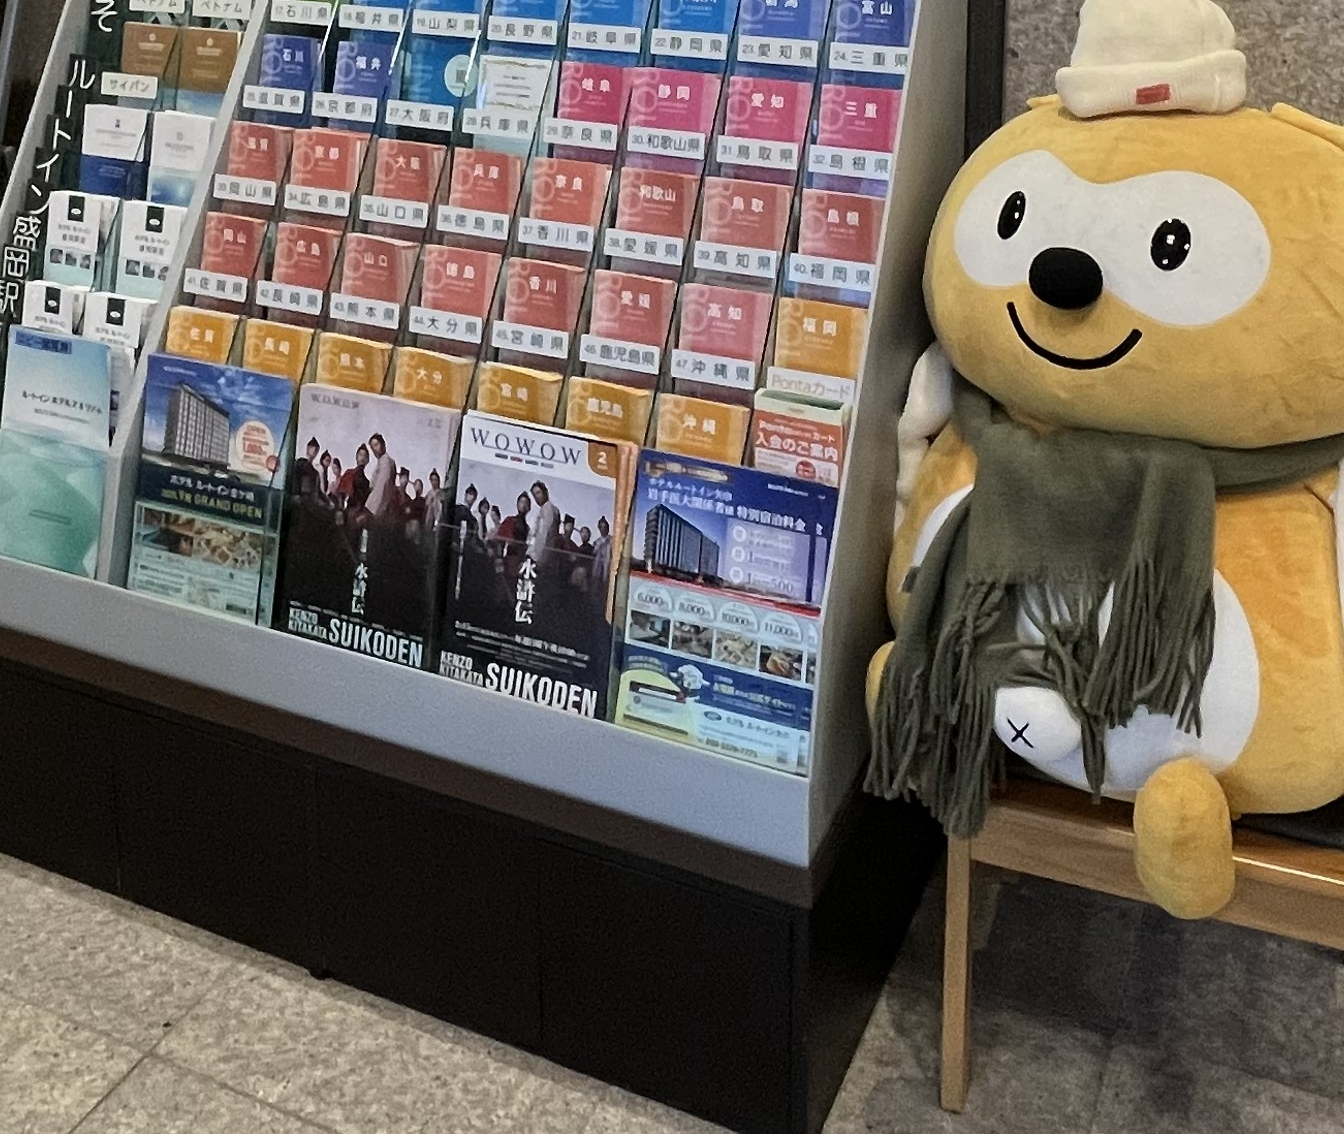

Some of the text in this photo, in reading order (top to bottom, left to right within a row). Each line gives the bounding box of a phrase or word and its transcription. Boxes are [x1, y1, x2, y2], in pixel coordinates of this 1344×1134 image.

[109, 79, 150, 93] サイパン
[416, 367, 443, 385] 大分
[771, 373, 851, 400] Pontaカード
[471, 427, 581, 466] WOWOW
[597, 451, 607, 465] 2
[232, 502, 263, 519] OPEN
[328, 618, 423, 668] SUIKODEN
[440, 650, 473, 671] KENZO
[485, 662, 598, 718] SUIKODEN
